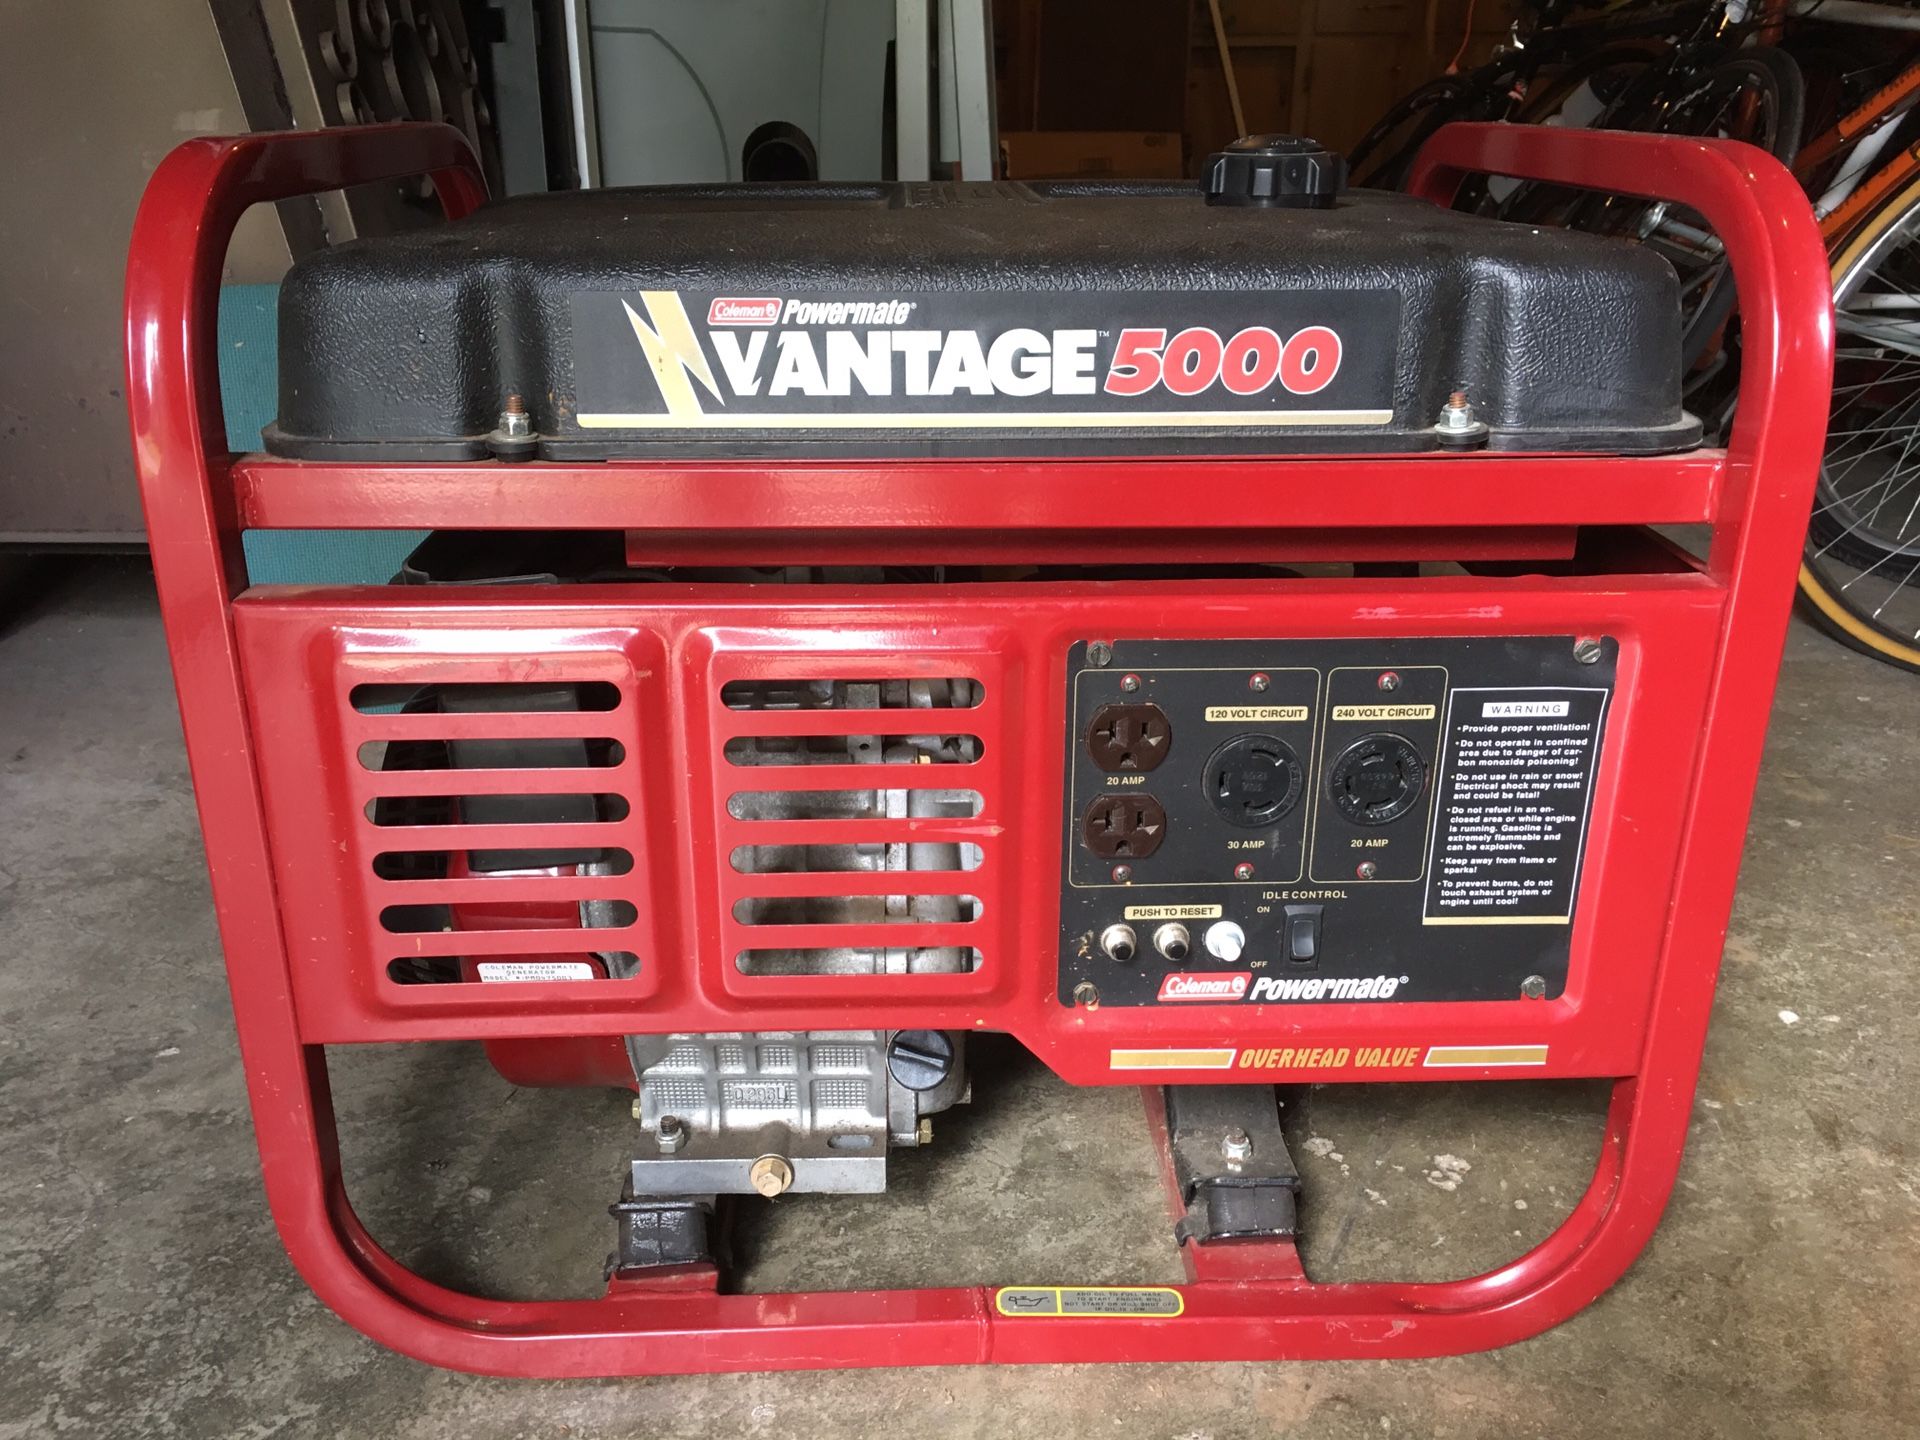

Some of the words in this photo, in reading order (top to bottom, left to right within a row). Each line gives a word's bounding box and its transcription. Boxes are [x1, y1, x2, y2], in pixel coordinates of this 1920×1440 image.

[714, 301, 764, 320] Coleman
[1104, 326, 1343, 396] 5000
[1210, 709, 1226, 719] 120
[1228, 709, 1257, 719] VOLT
[1259, 708, 1304, 718] CIRCUIT
[1337, 709, 1356, 718] 240
[1357, 708, 1386, 718] VOLT
[1387, 708, 1432, 717] CIRCUIT
[1491, 705, 1562, 714] WARNING
[1501, 725, 1533, 733] proper
[1536, 723, 1590, 731] ventilation!
[1495, 739, 1530, 748] operate
[1546, 738, 1588, 746] confined
[1516, 749, 1548, 757] danger
[1458, 758, 1476, 766] bon
[1479, 758, 1524, 766] monoxide
[1528, 758, 1579, 766] poisoning!
[1106, 777, 1122, 786] 20
[1124, 776, 1146, 785] AMP
[1456, 773, 1468, 781] Do
[1522, 772, 1538, 780] rain
[1455, 782, 1498, 790] Electrical
[1532, 782, 1550, 790] may
[1502, 791, 1513, 799] be
[1516, 791, 1540, 799] fatal!
[1545, 815, 1576, 823] engine
[1461, 825, 1498, 833] running.
[1448, 834, 1491, 842] extremely
[1227, 841, 1243, 849] 30
[1245, 840, 1265, 849] AMP
[1350, 839, 1367, 848] 20
[1368, 839, 1389, 848] AMP
[1445, 857, 1467, 865] Keep
[1520, 856, 1544, 864] flame
[1444, 866, 1477, 874] sparks!
[1443, 880, 1453, 888] To
[1456, 880, 1489, 888] prevent
[1492, 880, 1520, 888] burns,
[1263, 891, 1289, 899] IDLE
[1292, 890, 1347, 899] CONTROL
[1441, 889, 1466, 897] touch
[1507, 889, 1538, 897] system
[1440, 899, 1470, 907] engine
[1132, 907, 1163, 918] PUSH
[1164, 907, 1179, 917] TO
[1181, 906, 1215, 917] RESET
[1165, 976, 1230, 995] Coleman
[1239, 1048, 1350, 1069] OVERHEAD
